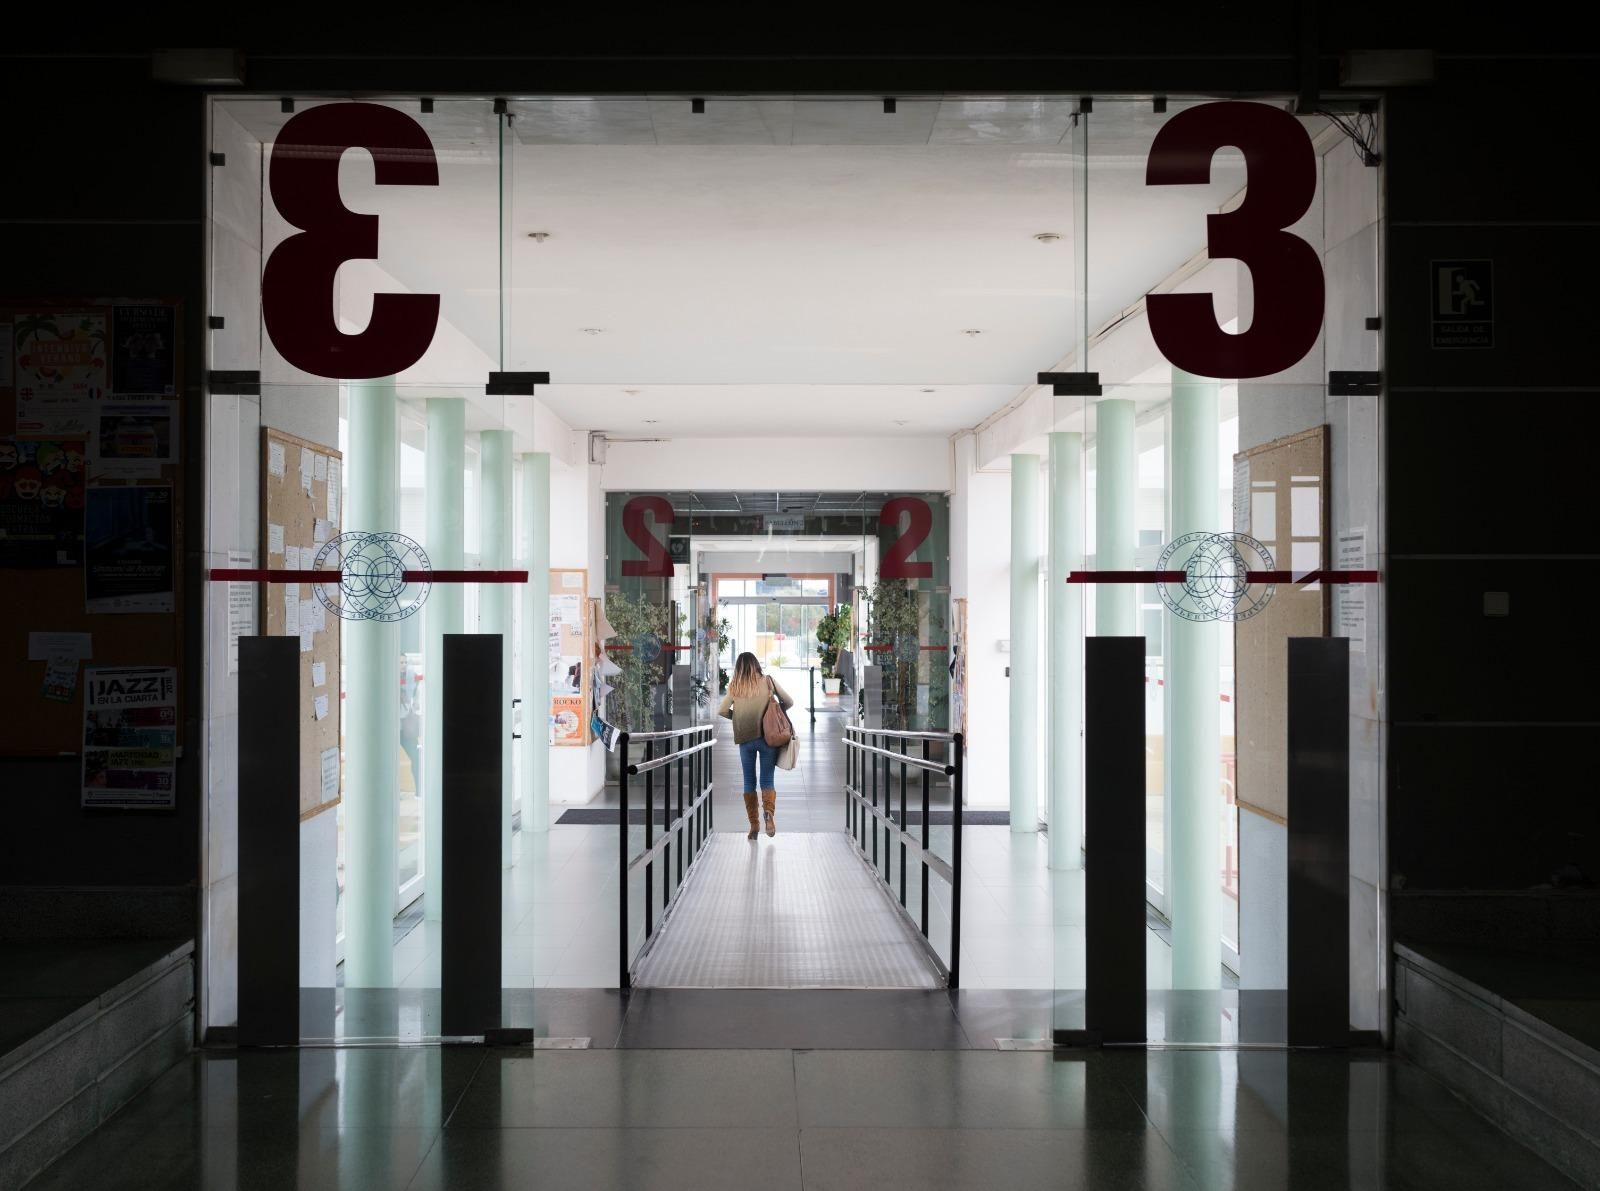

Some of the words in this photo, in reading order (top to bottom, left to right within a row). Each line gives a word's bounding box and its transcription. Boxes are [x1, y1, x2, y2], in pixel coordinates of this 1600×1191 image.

[1145, 100, 1326, 379] 3
[1472, 325, 1489, 333] DE
[879, 496, 933, 578] 2
[97, 677, 159, 696] JAZZ
[97, 697, 109, 705] EN
[110, 695, 122, 704] LA
[124, 694, 159, 703] CUARTA
